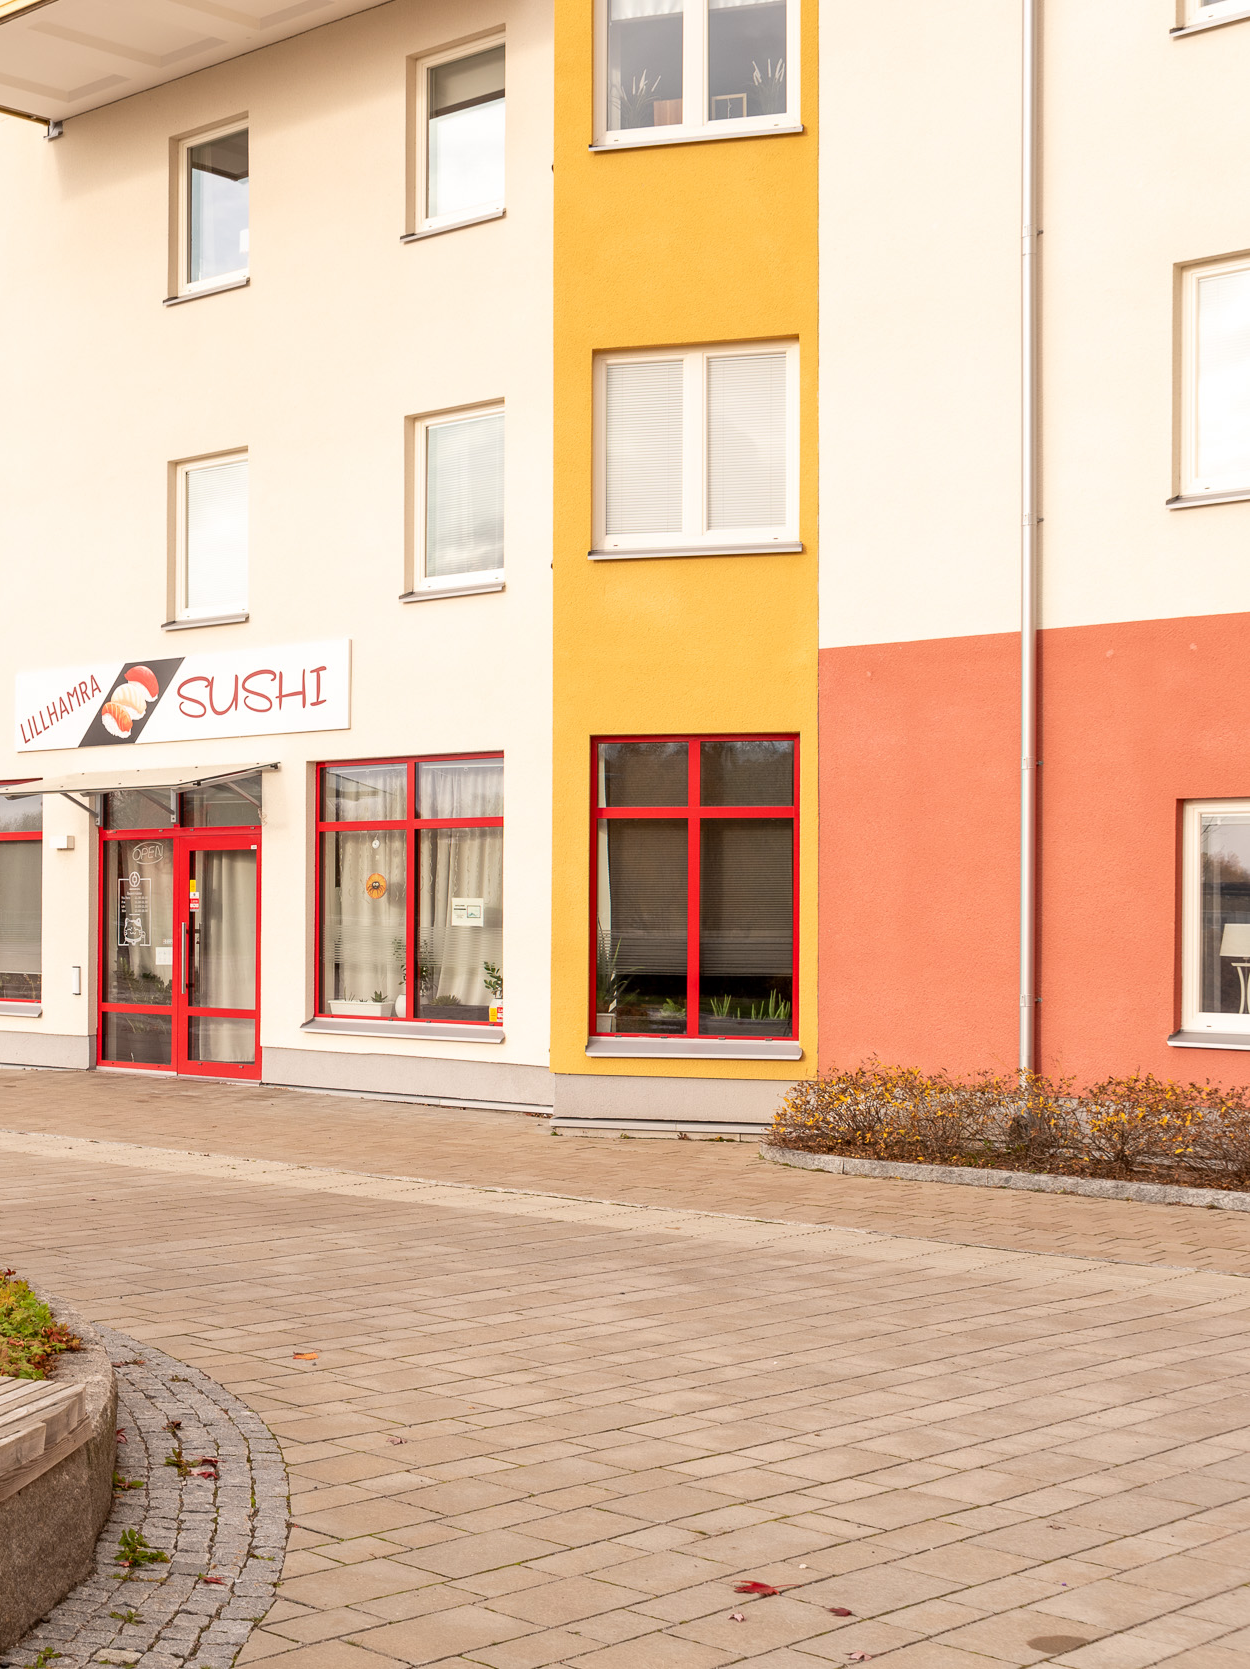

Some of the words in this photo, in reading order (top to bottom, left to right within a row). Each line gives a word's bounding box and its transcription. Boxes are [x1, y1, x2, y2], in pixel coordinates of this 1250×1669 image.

[20, 674, 102, 744] LILLHAMRA
[177, 665, 327, 718] SUSHI
[132, 845, 164, 861] OPEN
